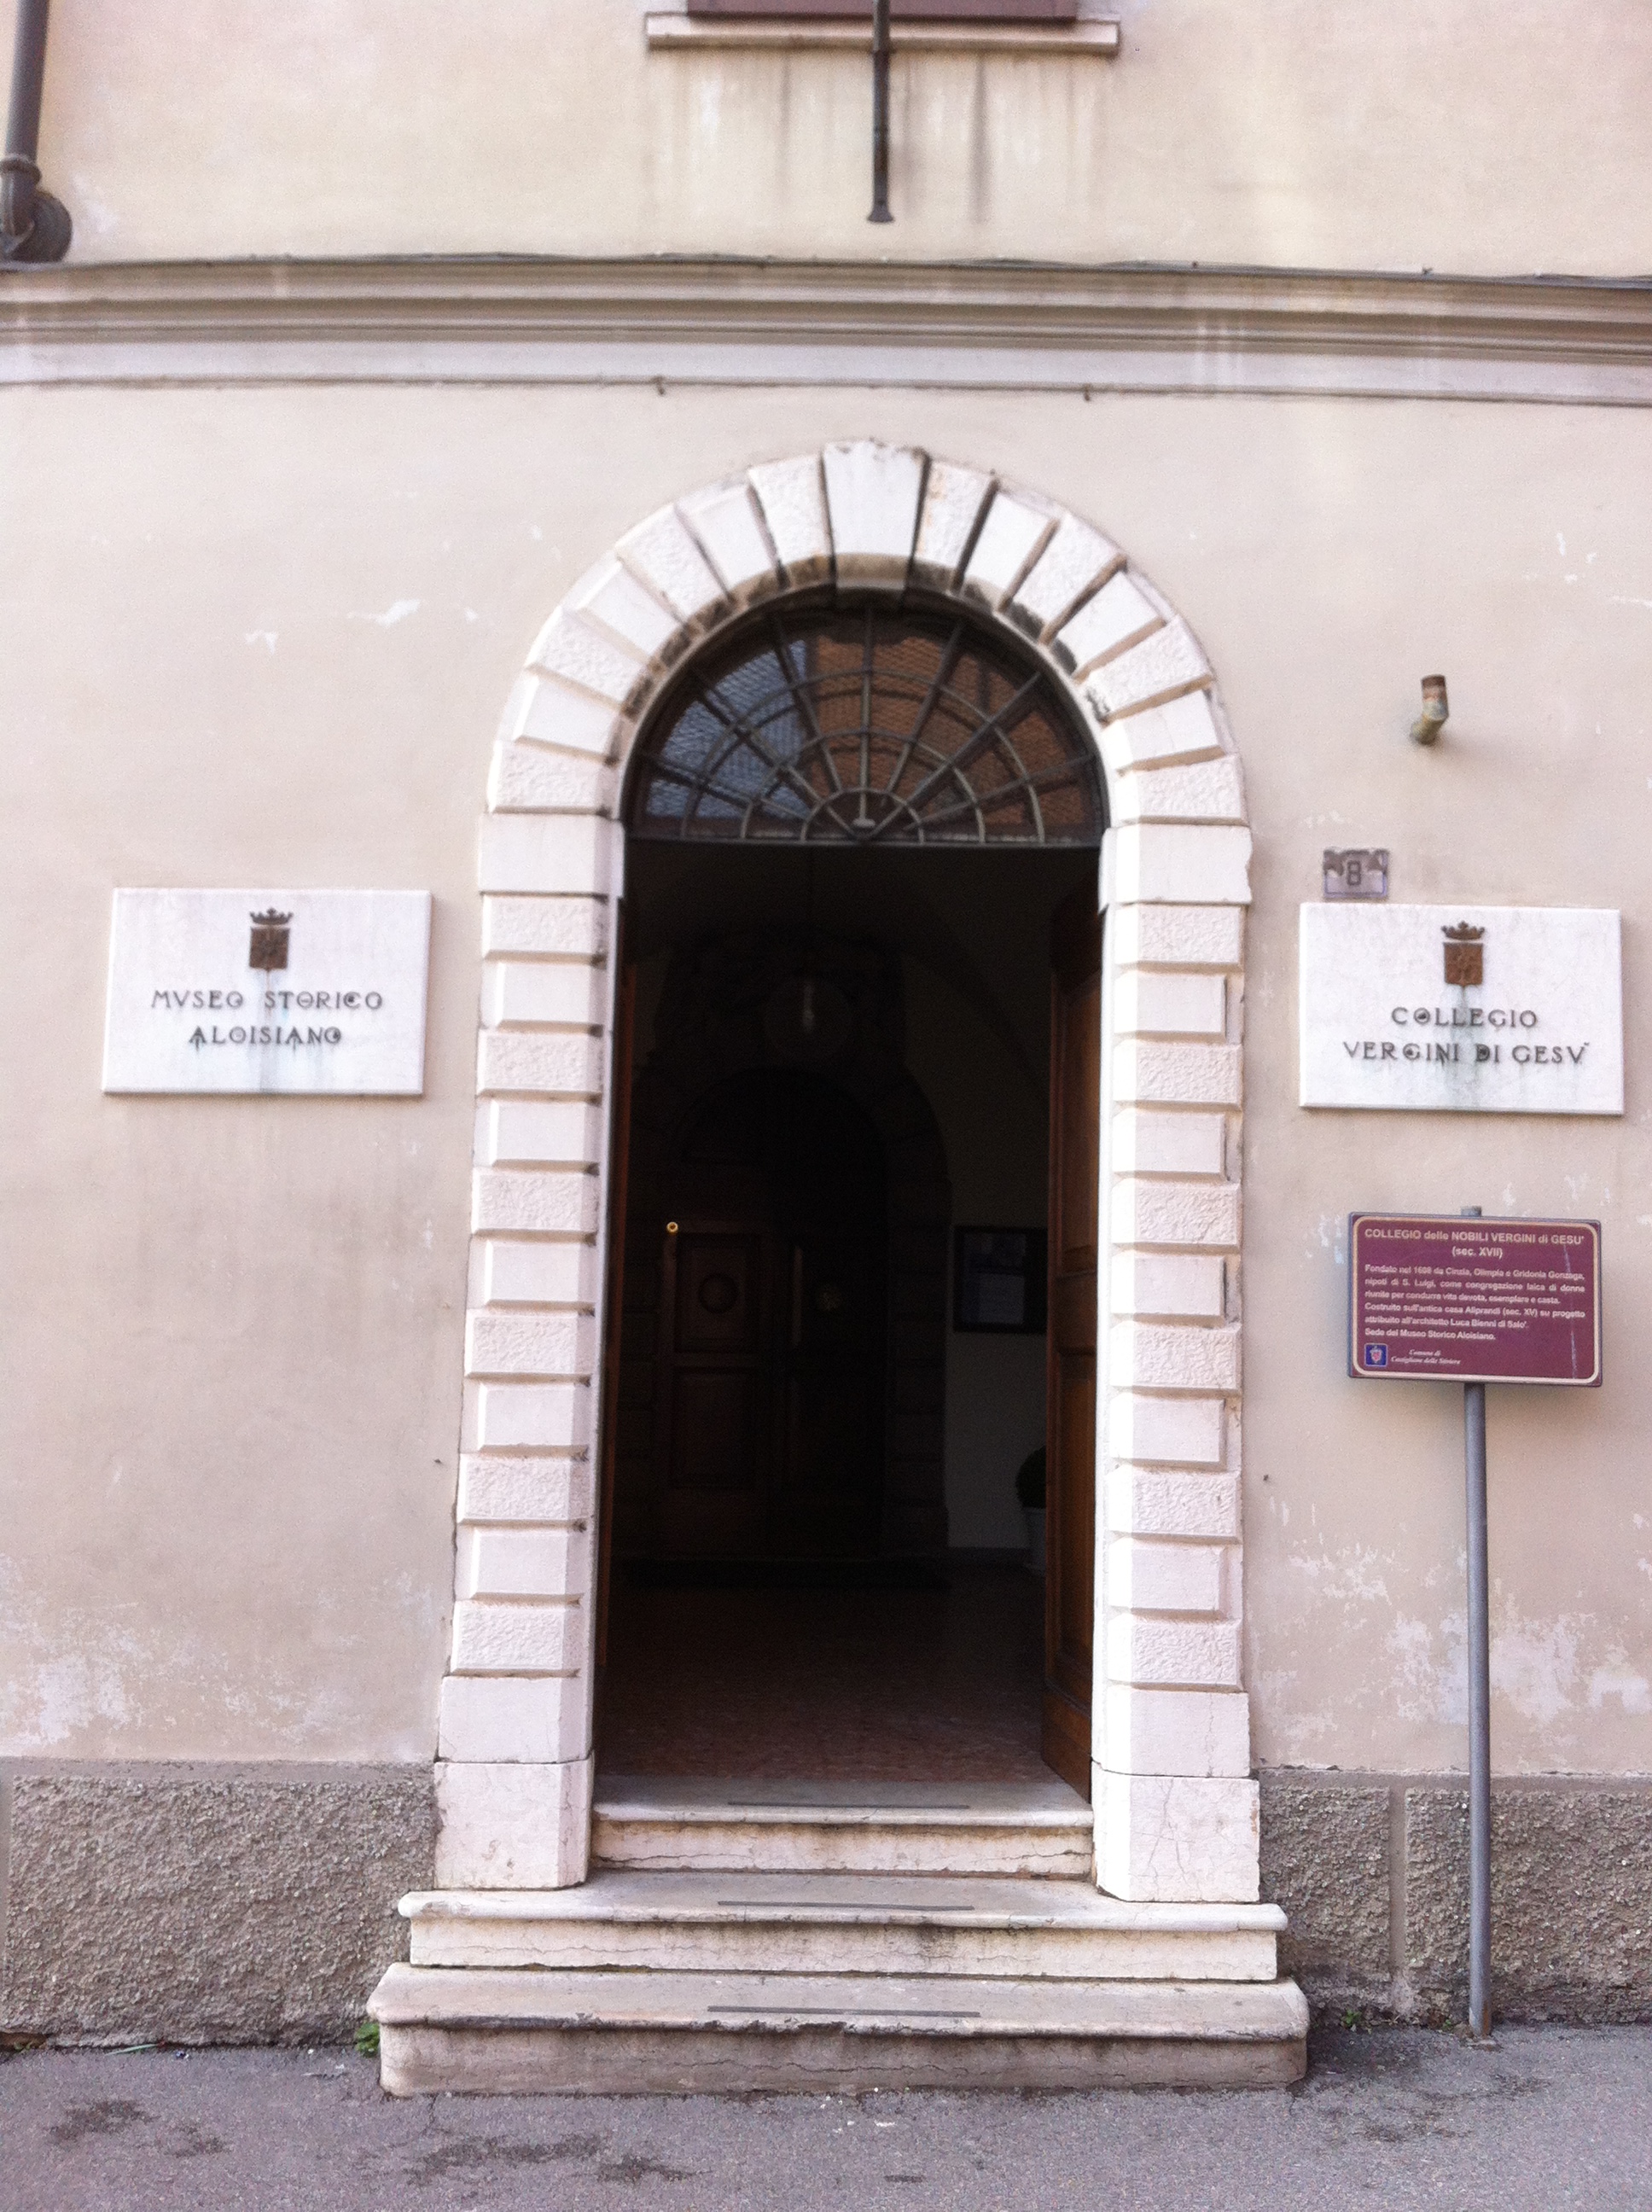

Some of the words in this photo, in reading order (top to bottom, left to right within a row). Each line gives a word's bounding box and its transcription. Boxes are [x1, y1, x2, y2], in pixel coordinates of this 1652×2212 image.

[1347, 860, 1362, 886] 8
[151, 990, 244, 1009] MVSEO
[264, 990, 383, 1010] STORICO
[1391, 1006, 1539, 1027] COLLEGIO
[189, 1026, 342, 1045] ALOISIANO
[1343, 1040, 1458, 1063] VERGINI
[1474, 1043, 1499, 1063] DI
[1364, 1228, 1422, 1239] COLLEGIO
[1423, 1231, 1449, 1240] delle
[1451, 1231, 1488, 1242] NOBILI
[1491, 1232, 1535, 1243] VERGINI
[1538, 1234, 1549, 1244] di
[1550, 1235, 1585, 1245] GESU'
[1451, 1245, 1475, 1257] (sec.
[1479, 1247, 1503, 1259] XVII)
[1364, 1264, 1398, 1274] Fondato
[1446, 1267, 1472, 1277] Cinzia,
[1474, 1268, 1504, 1278] Olimpia
[1513, 1270, 1547, 1278] Gridonia
[1548, 1271, 1585, 1281] Gonzaga,
[1364, 1278, 1387, 1287] nipoti
[1465, 1281, 1523, 1291] congregazione
[1527, 1283, 1545, 1291] laica
[1560, 1284, 1585, 1293] donne
[1364, 1289, 1390, 1299] riunite
[1391, 1292, 1405, 1301] per
[1405, 1292, 1442, 1301] condurre
[1443, 1292, 1457, 1301] vita
[1458, 1293, 1488, 1303] devota,
[1489, 1295, 1530, 1304] esemplare
[1537, 1296, 1561, 1305] casta.
[1364, 1301, 1401, 1312] Costruito
[1403, 1303, 1443, 1313] sull'antica
[1465, 1305, 1501, 1317] Aliprandi
[1503, 1307, 1522, 1317] (sec.
[1523, 1307, 1538, 1318] XV)
[1552, 1310, 1585, 1319] progetto
[1364, 1316, 1400, 1324] attribuito
[1401, 1316, 1449, 1326] all'architetto
[1450, 1318, 1470, 1326] Luca
[1471, 1318, 1497, 1328] Bienni
[1364, 1327, 1385, 1336] Sede
[1399, 1329, 1427, 1338] Museo
[1428, 1330, 1457, 1339] Storico
[1457, 1331, 1497, 1341] Aloisiano.
